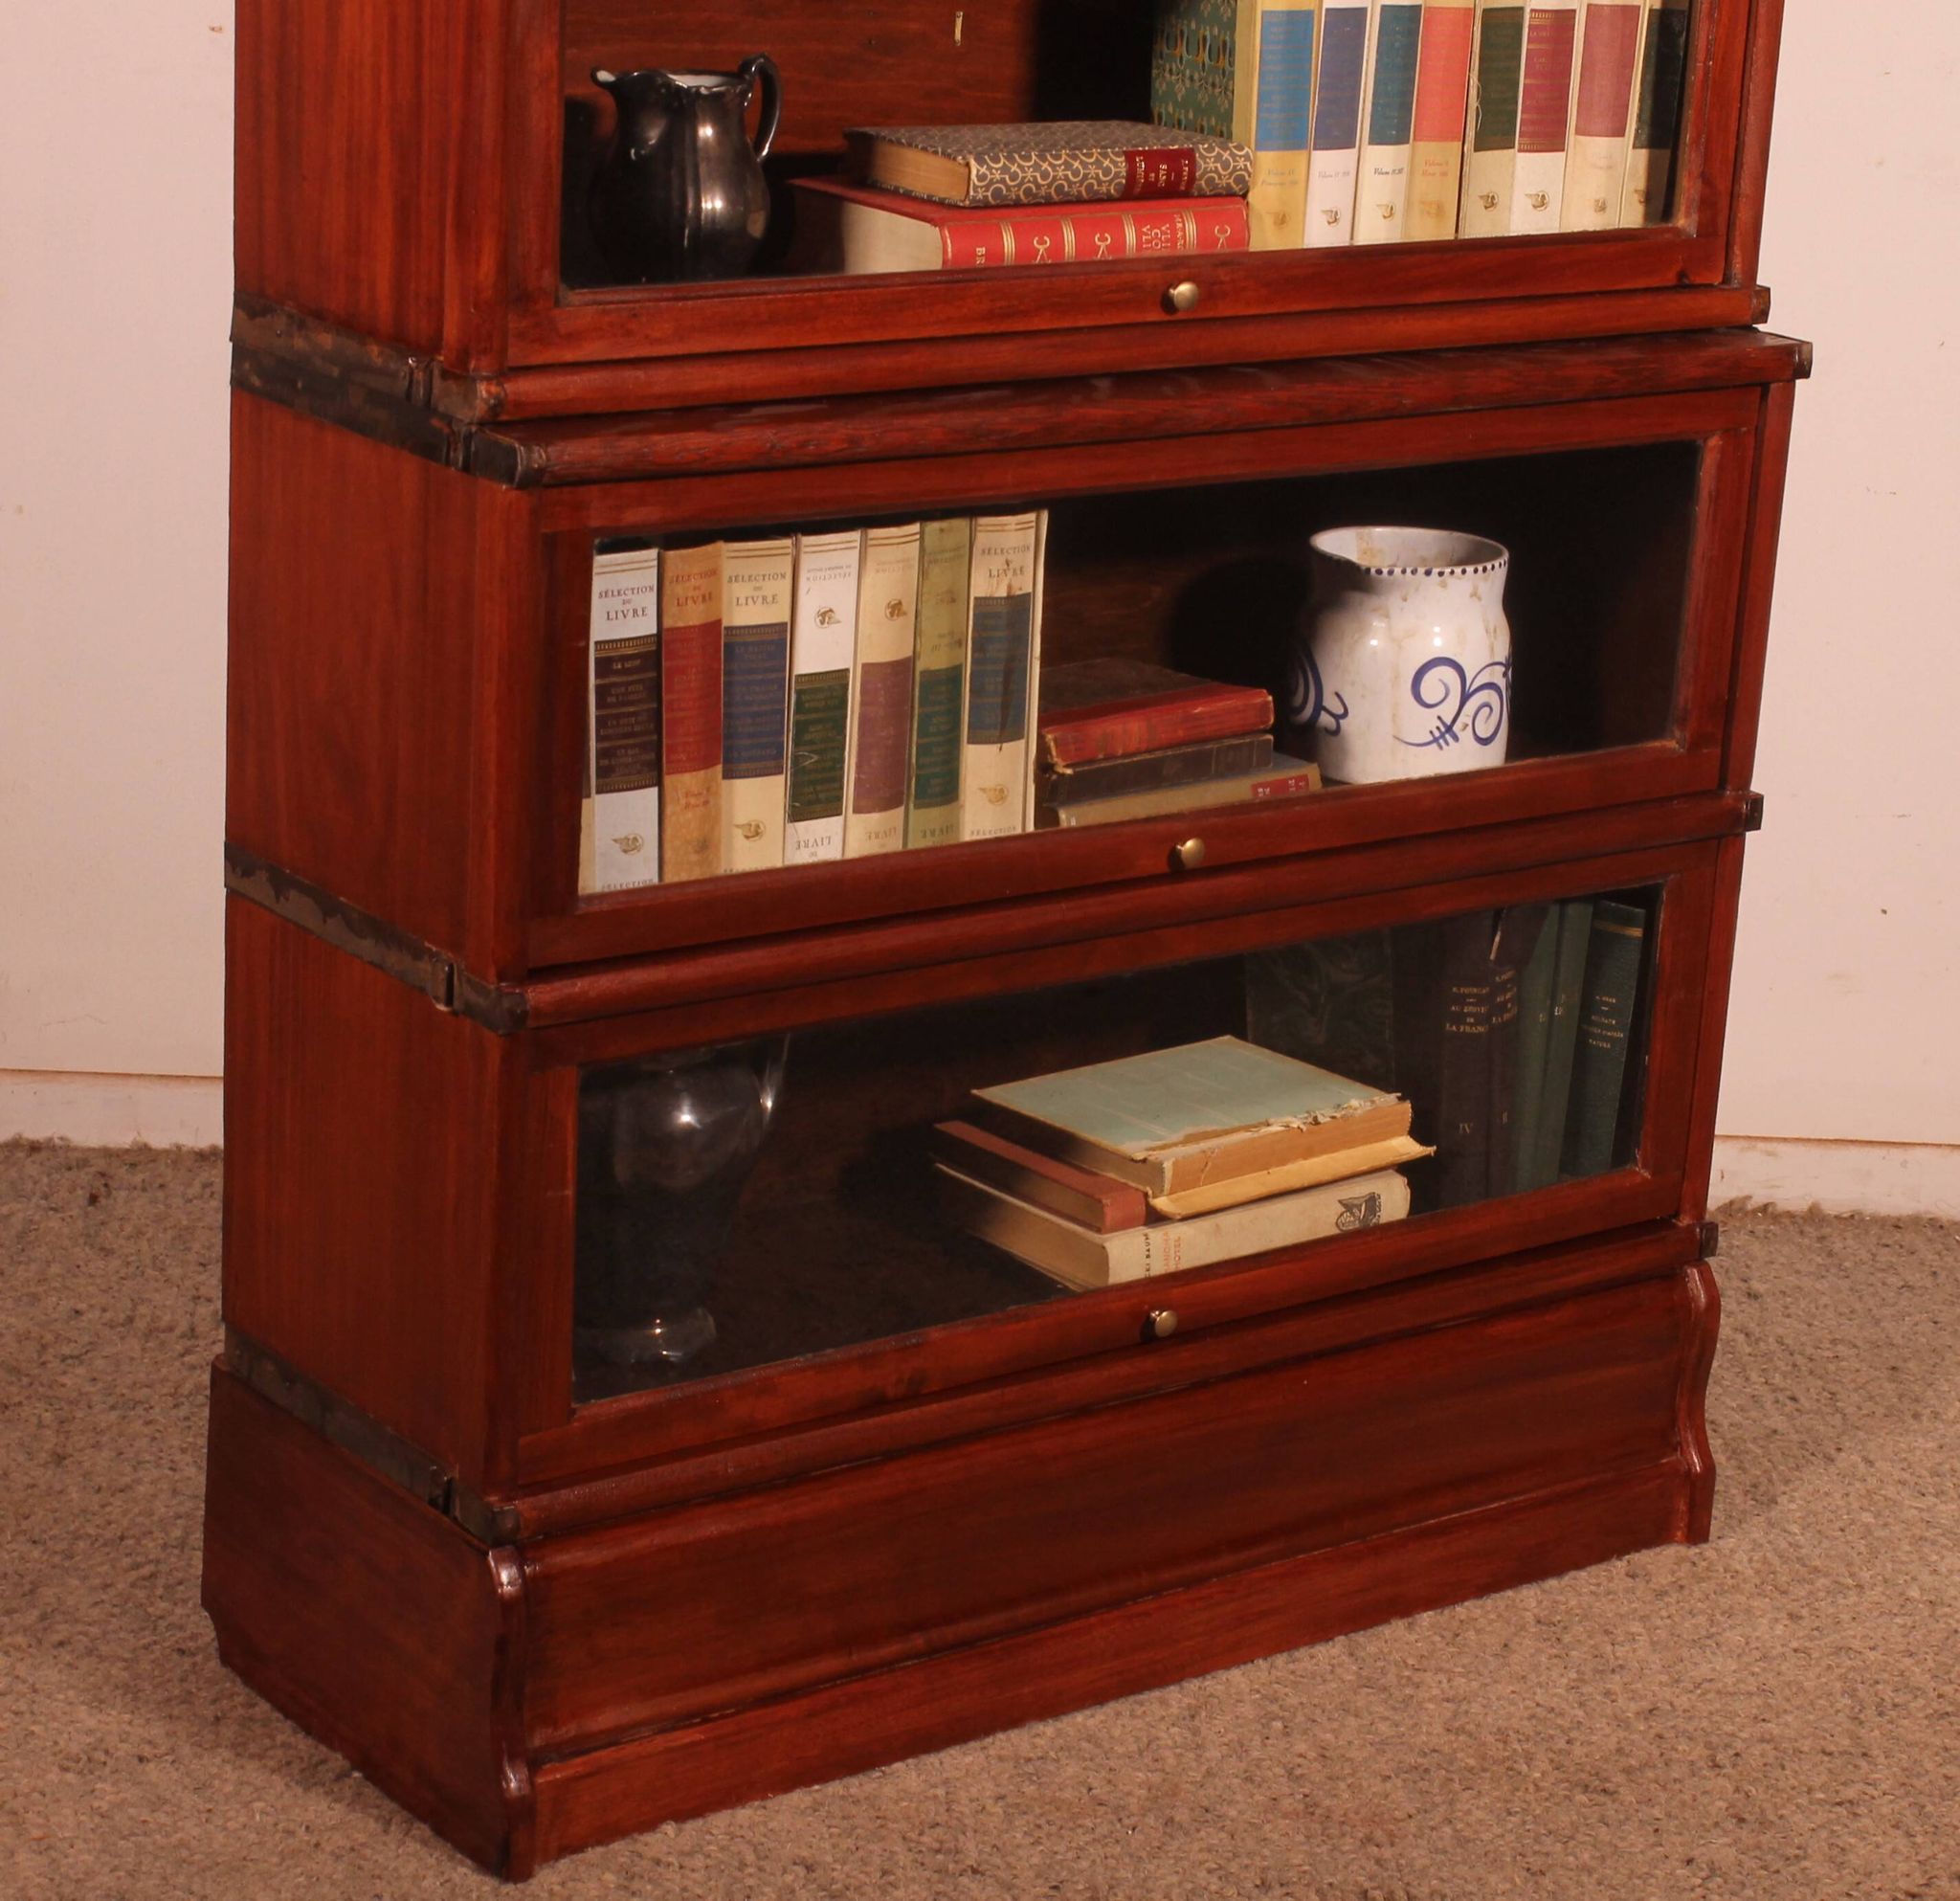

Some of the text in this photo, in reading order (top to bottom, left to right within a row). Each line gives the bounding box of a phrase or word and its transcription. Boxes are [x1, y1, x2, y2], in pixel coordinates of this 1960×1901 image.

[670, 568, 719, 584] SÉLECTION
[727, 571, 788, 585] SÉLECTION
[989, 565, 1025, 579] LIVRE
[598, 584, 655, 600] SÉLECTION
[676, 592, 713, 607] LIVRE
[736, 593, 779, 607] LIVRE
[606, 606, 649, 621] LIVRE
[865, 826, 898, 841] LIVRE
[920, 823, 955, 839] LIVRE
[795, 836, 832, 850] LIVRE
[1459, 1123, 1473, 1134] IV
